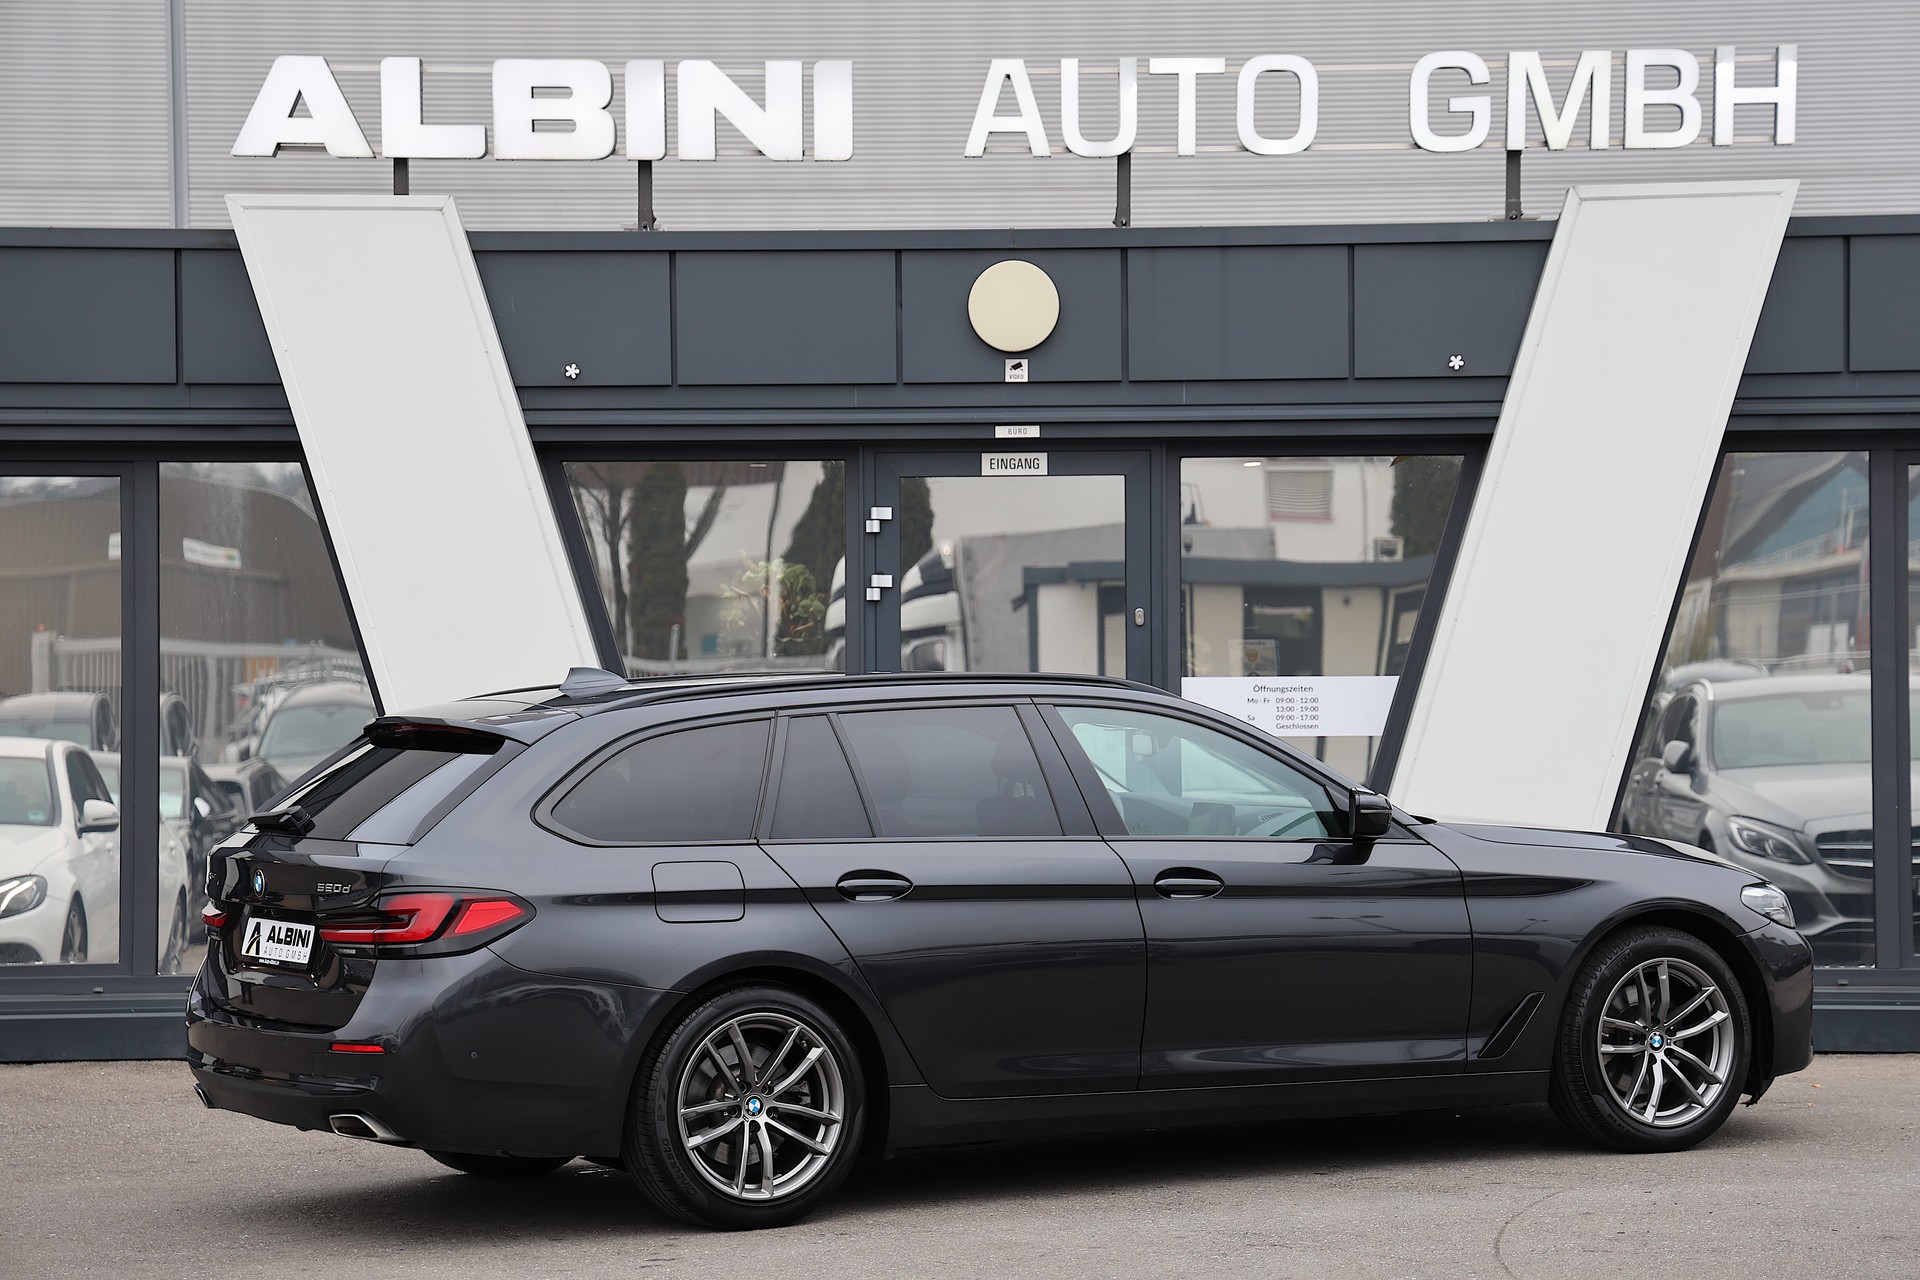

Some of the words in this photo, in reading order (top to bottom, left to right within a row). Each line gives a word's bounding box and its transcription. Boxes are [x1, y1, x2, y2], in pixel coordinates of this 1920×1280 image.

[230, 55, 854, 161] ALBINI
[964, 53, 1319, 158] AUTO
[1407, 44, 1799, 154] GMBH
[1007, 427, 1028, 435] BÜRO
[989, 457, 1040, 470] EINGANG
[1253, 684, 1314, 694] Öffnungszeiten
[316, 883, 351, 894] 520d
[266, 925, 311, 948] ALBINI
[263, 946, 283, 958] AUTO
